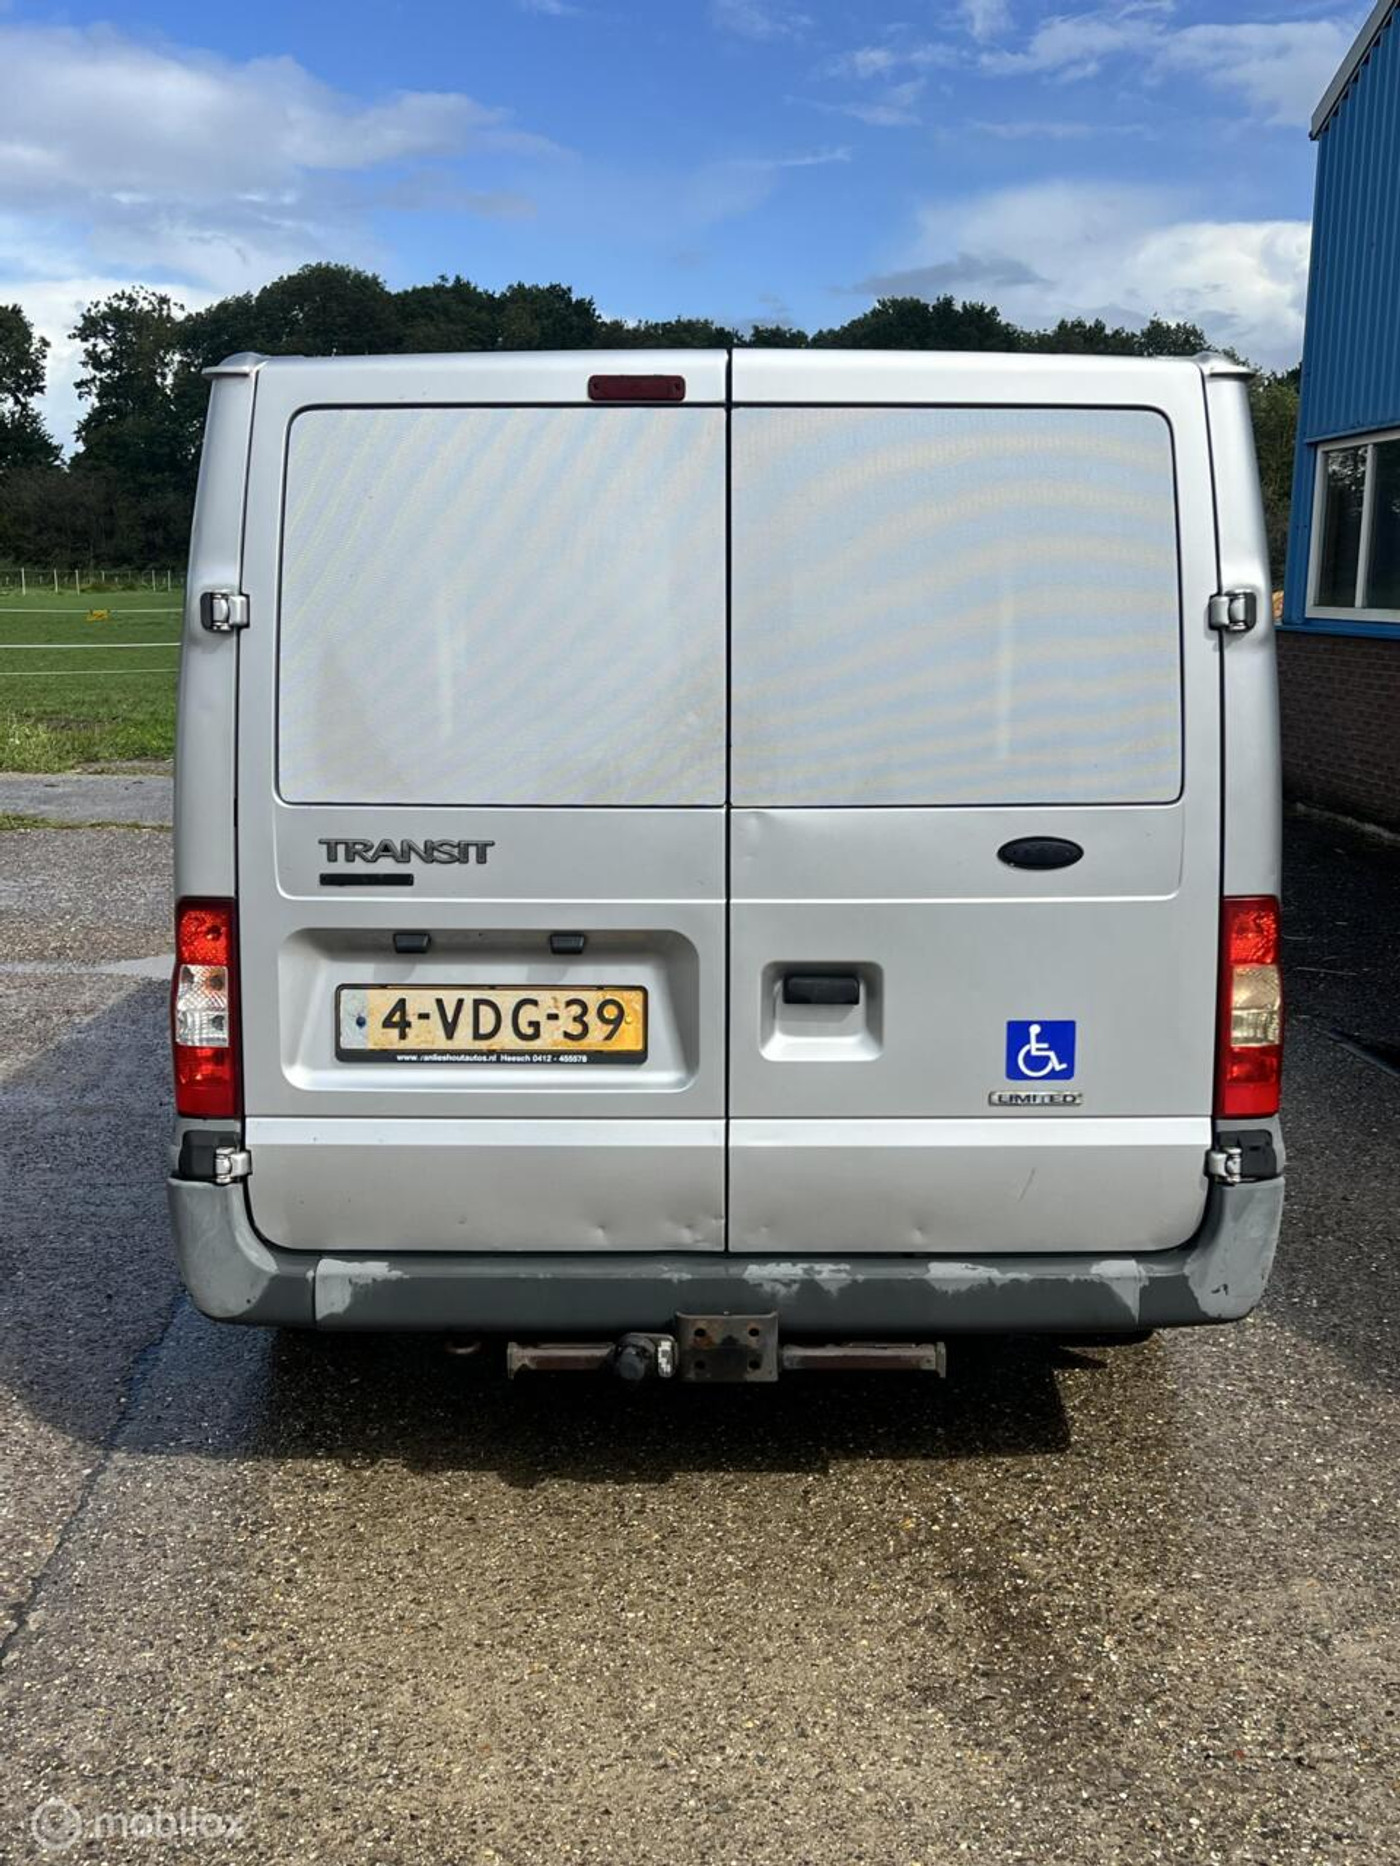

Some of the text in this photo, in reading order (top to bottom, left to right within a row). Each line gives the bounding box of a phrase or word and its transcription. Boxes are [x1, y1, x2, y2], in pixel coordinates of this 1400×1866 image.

[318, 839, 496, 864] TRANSIT
[381, 997, 625, 1041] 4-VDG-39
[500, 1053, 531, 1062] Heesch
[532, 1054, 552, 1063] 0412
[998, 1093, 1077, 1104] LIMITED
